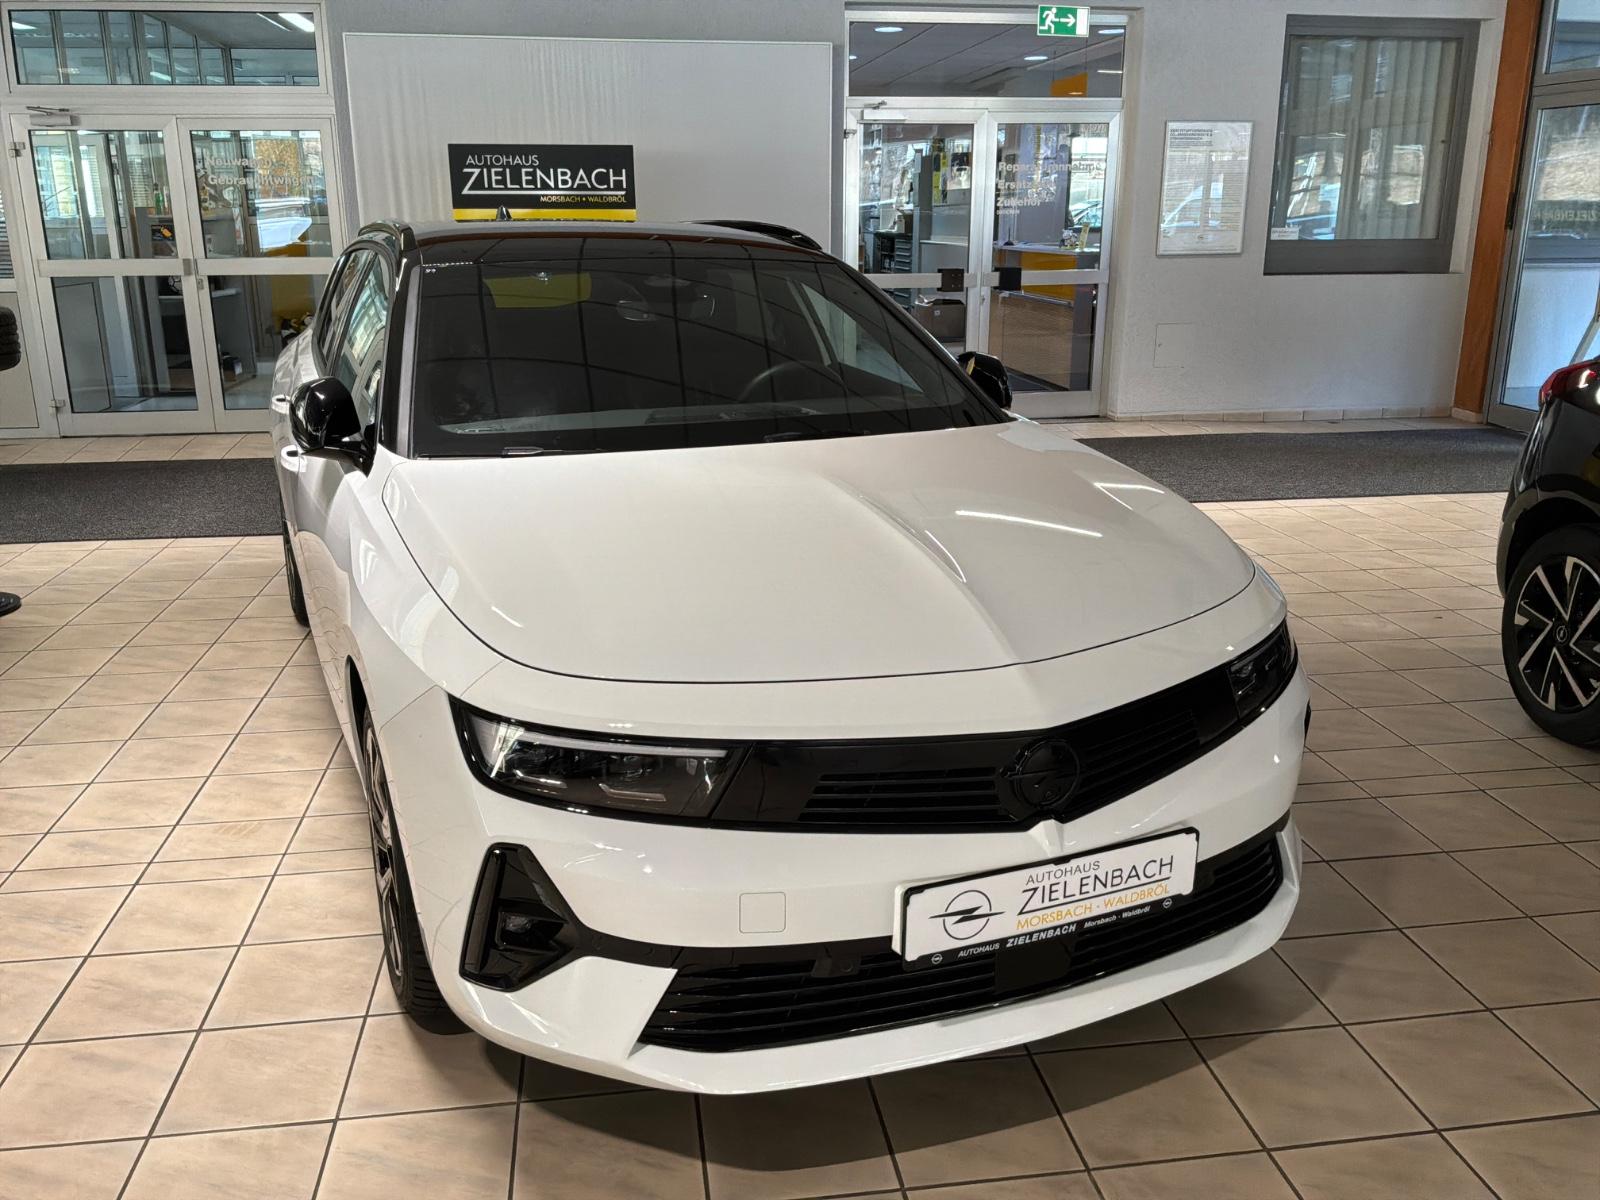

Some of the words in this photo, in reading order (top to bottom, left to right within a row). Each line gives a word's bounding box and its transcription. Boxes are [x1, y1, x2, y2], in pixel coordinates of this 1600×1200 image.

[466, 154, 539, 166] AUTOHAUS
[462, 168, 626, 194] ZIELENBACH
[540, 195, 581, 203] MORSBACH
[1017, 855, 1173, 916] ZIELENBACH
[1026, 861, 1100, 886] AUTOHAUS
[1016, 903, 1093, 930] MORSBACH
[1103, 883, 1169, 909] WALDBRÖL
[958, 943, 1000, 958] AUTOHAUS
[1006, 923, 1077, 948] ZIELENBACH
[1084, 915, 1117, 929] Morsbach
[1122, 905, 1151, 919] Waldbröl
